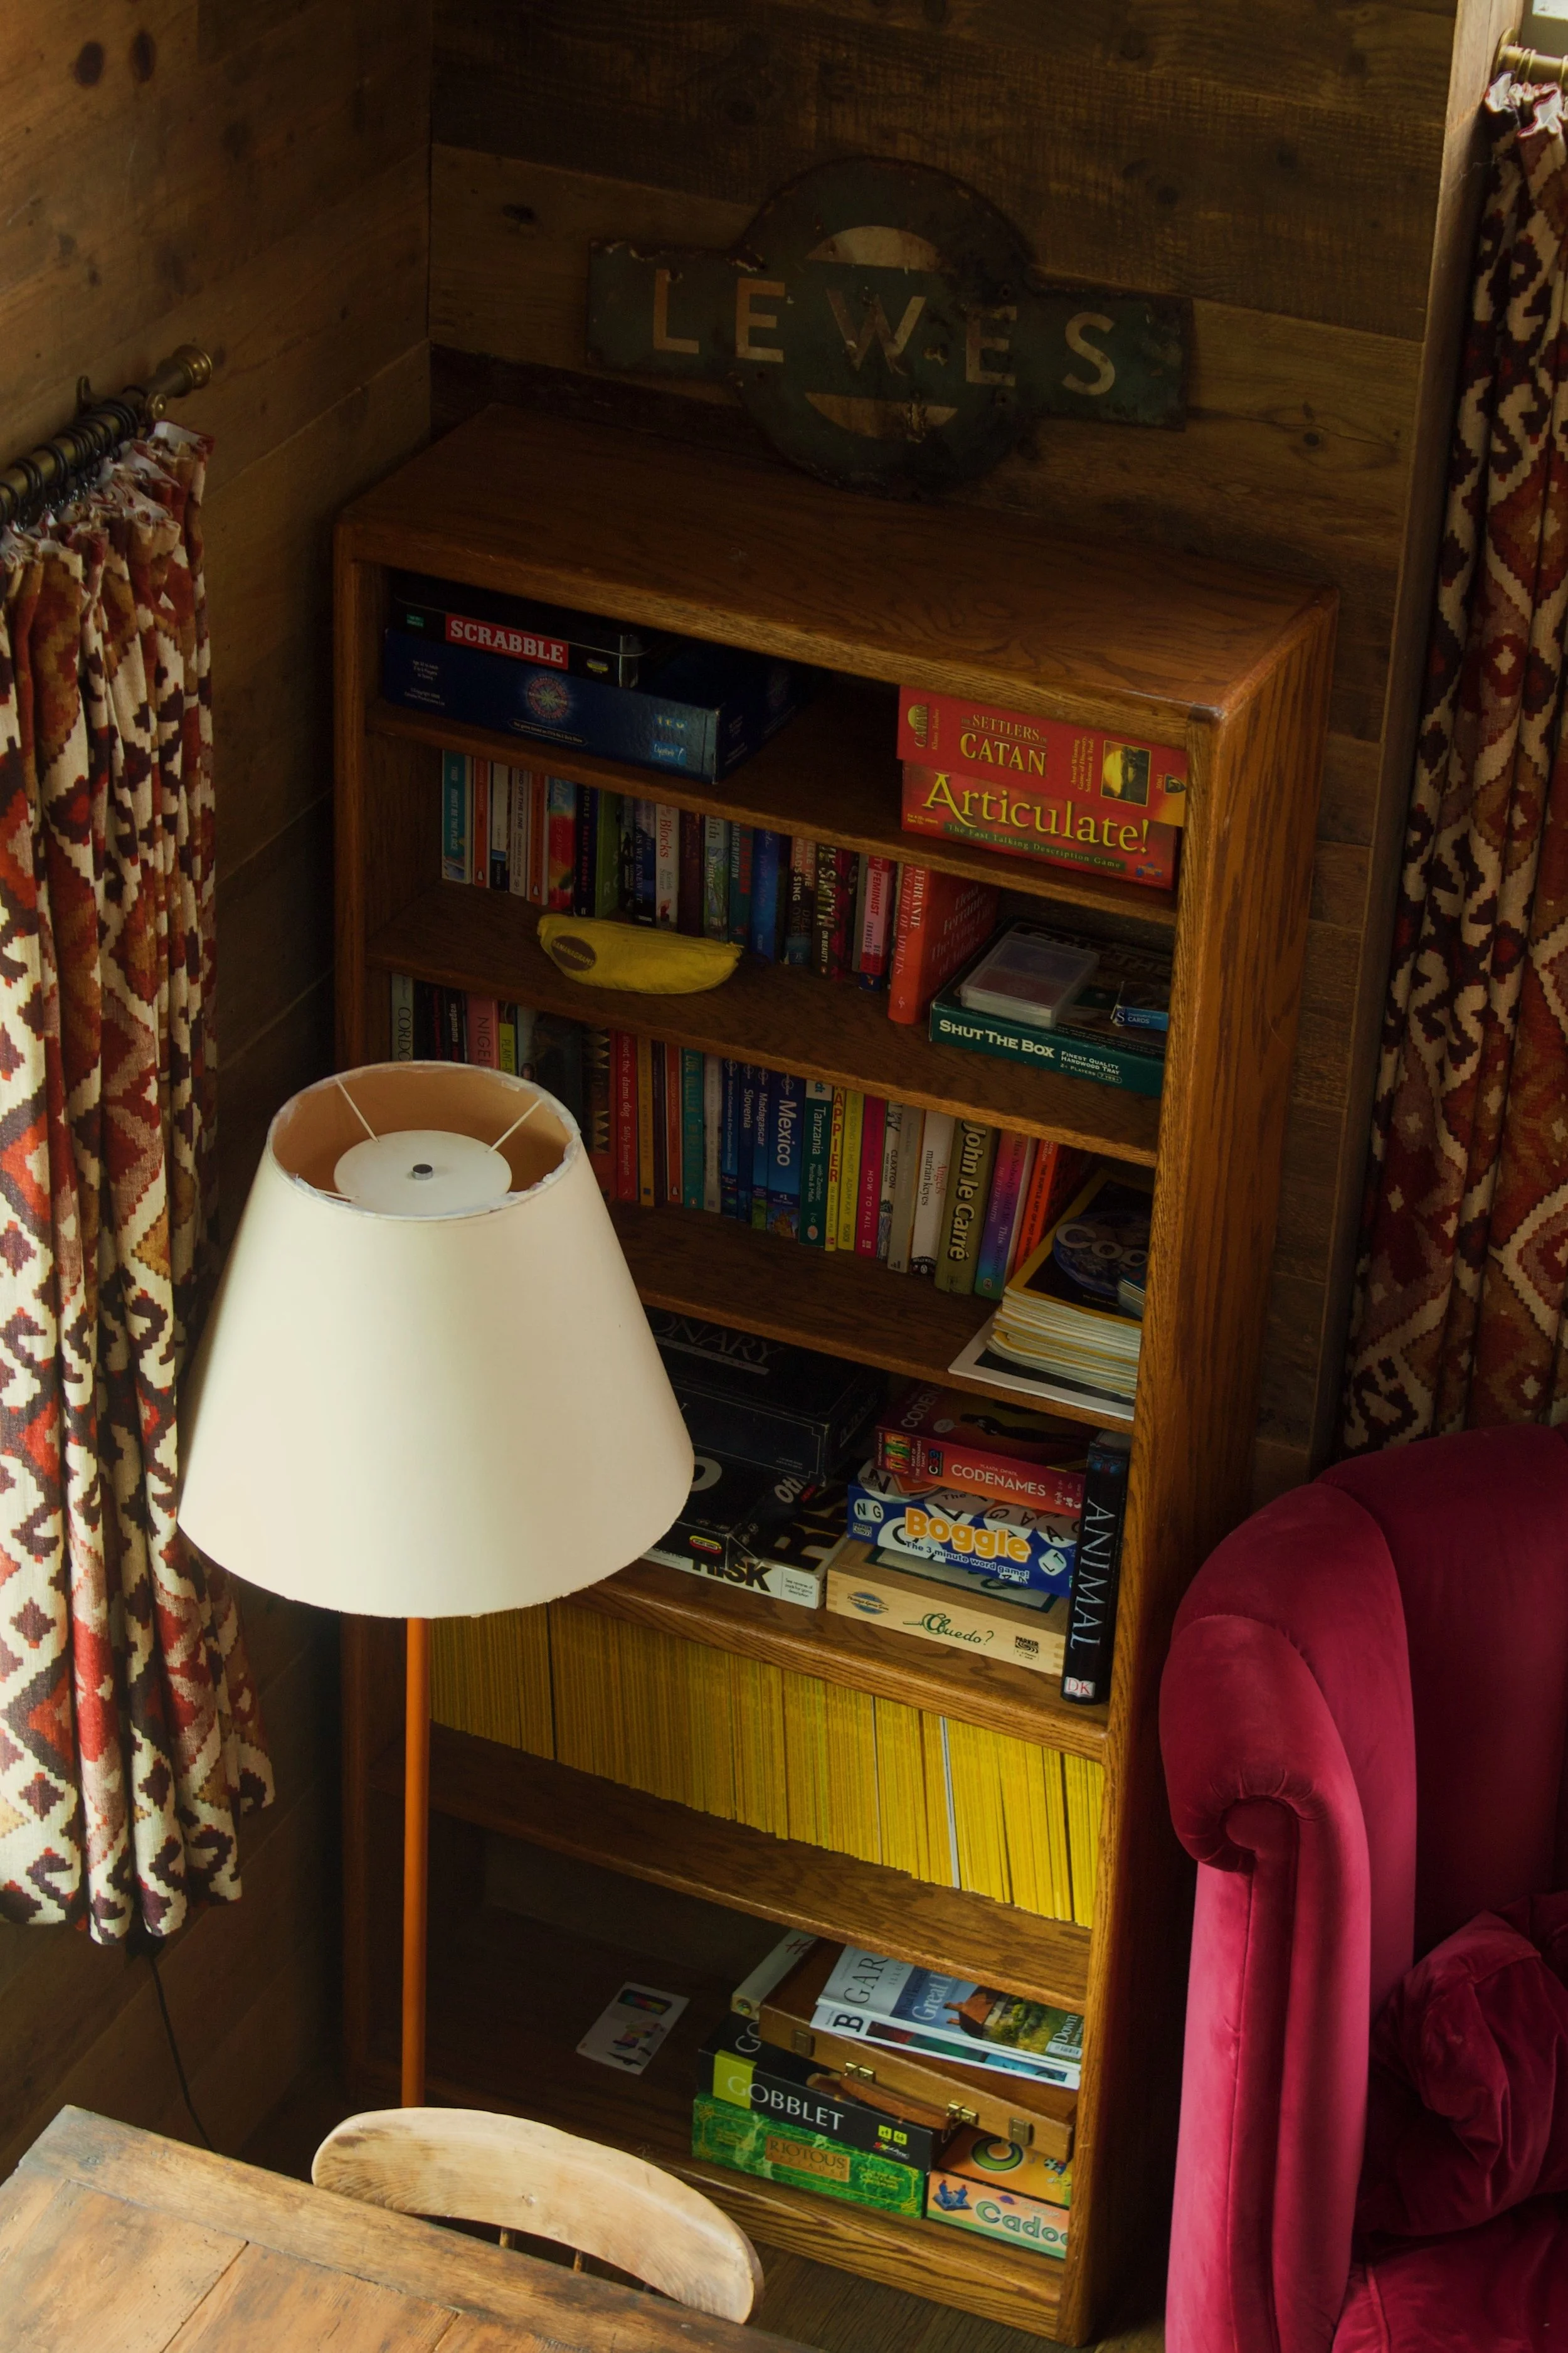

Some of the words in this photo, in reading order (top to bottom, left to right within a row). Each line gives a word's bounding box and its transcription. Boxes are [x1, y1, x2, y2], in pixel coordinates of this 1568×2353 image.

[653, 268, 1117, 396] LEWES
[450, 619, 565, 664] SCRABBLE
[972, 714, 1040, 741] SETTLERS
[960, 733, 1047, 777] CATAN
[518, 787, 524, 796] OF
[922, 772, 1149, 854] Articulate!
[636, 847, 642, 861] WE
[660, 819, 671, 858] Blocks
[948, 824, 965, 834] The
[969, 828, 988, 841] Fast
[993, 834, 1029, 851] Talking
[1033, 843, 1090, 862] Description
[1094, 857, 1121, 869] Game
[792, 876, 802, 901] SING
[817, 866, 836, 928] SMITH
[870, 871, 881, 915] FEMINIST
[910, 869, 924, 928] FERRANTE
[822, 930, 828, 939] ON
[449, 1003, 459, 1043] wagamama
[1128, 1015, 1150, 1024] CARDS
[477, 1016, 491, 1066] NIGEL
[940, 1019, 983, 1039] SHUT
[983, 1029, 1019, 1049] THE
[1022, 1039, 1056, 1060] BOX
[1061, 1051, 1088, 1062] FINEST
[1089, 1058, 1120, 1070] QUALITY
[1061, 1056, 1100, 1070] HARDWOOD
[1102, 1065, 1121, 1075] TRAY
[1070, 1066, 1097, 1077] PLAYERS
[622, 1076, 630, 1099] damn
[620, 1100, 632, 1118] dog
[743, 1088, 753, 1129] Slovenia
[756, 1091, 766, 1147] Madagascar
[622, 1125, 630, 1142] Sally
[776, 1099, 796, 1167] Mexico
[812, 1105, 825, 1155] Tanzania
[829, 1090, 843, 1184] APPIER
[956, 1122, 987, 1176] John
[889, 1149, 898, 1189] CLAXTON
[923, 1150, 935, 1181] marian
[933, 1163, 947, 1195] Angels
[866, 1196, 872, 1207] TO
[919, 1182, 932, 1206] keyes
[955, 1178, 978, 1201] le
[947, 1203, 976, 1263] Carré
[996, 1226, 1008, 1244] This
[951, 1464, 1047, 1497] CODENAMES
[905, 1507, 1032, 1563] Boggle
[905, 1541, 924, 1552] The
[934, 1549, 969, 1564] minute
[970, 1557, 997, 1570] word
[999, 1564, 1030, 1578] game!
[1070, 1496, 1116, 1650] ANIMAL
[1069, 1679, 1091, 1694] DK
[728, 2076, 845, 2131] GOBBLET
[770, 2138, 846, 2170] RIOTOUS
